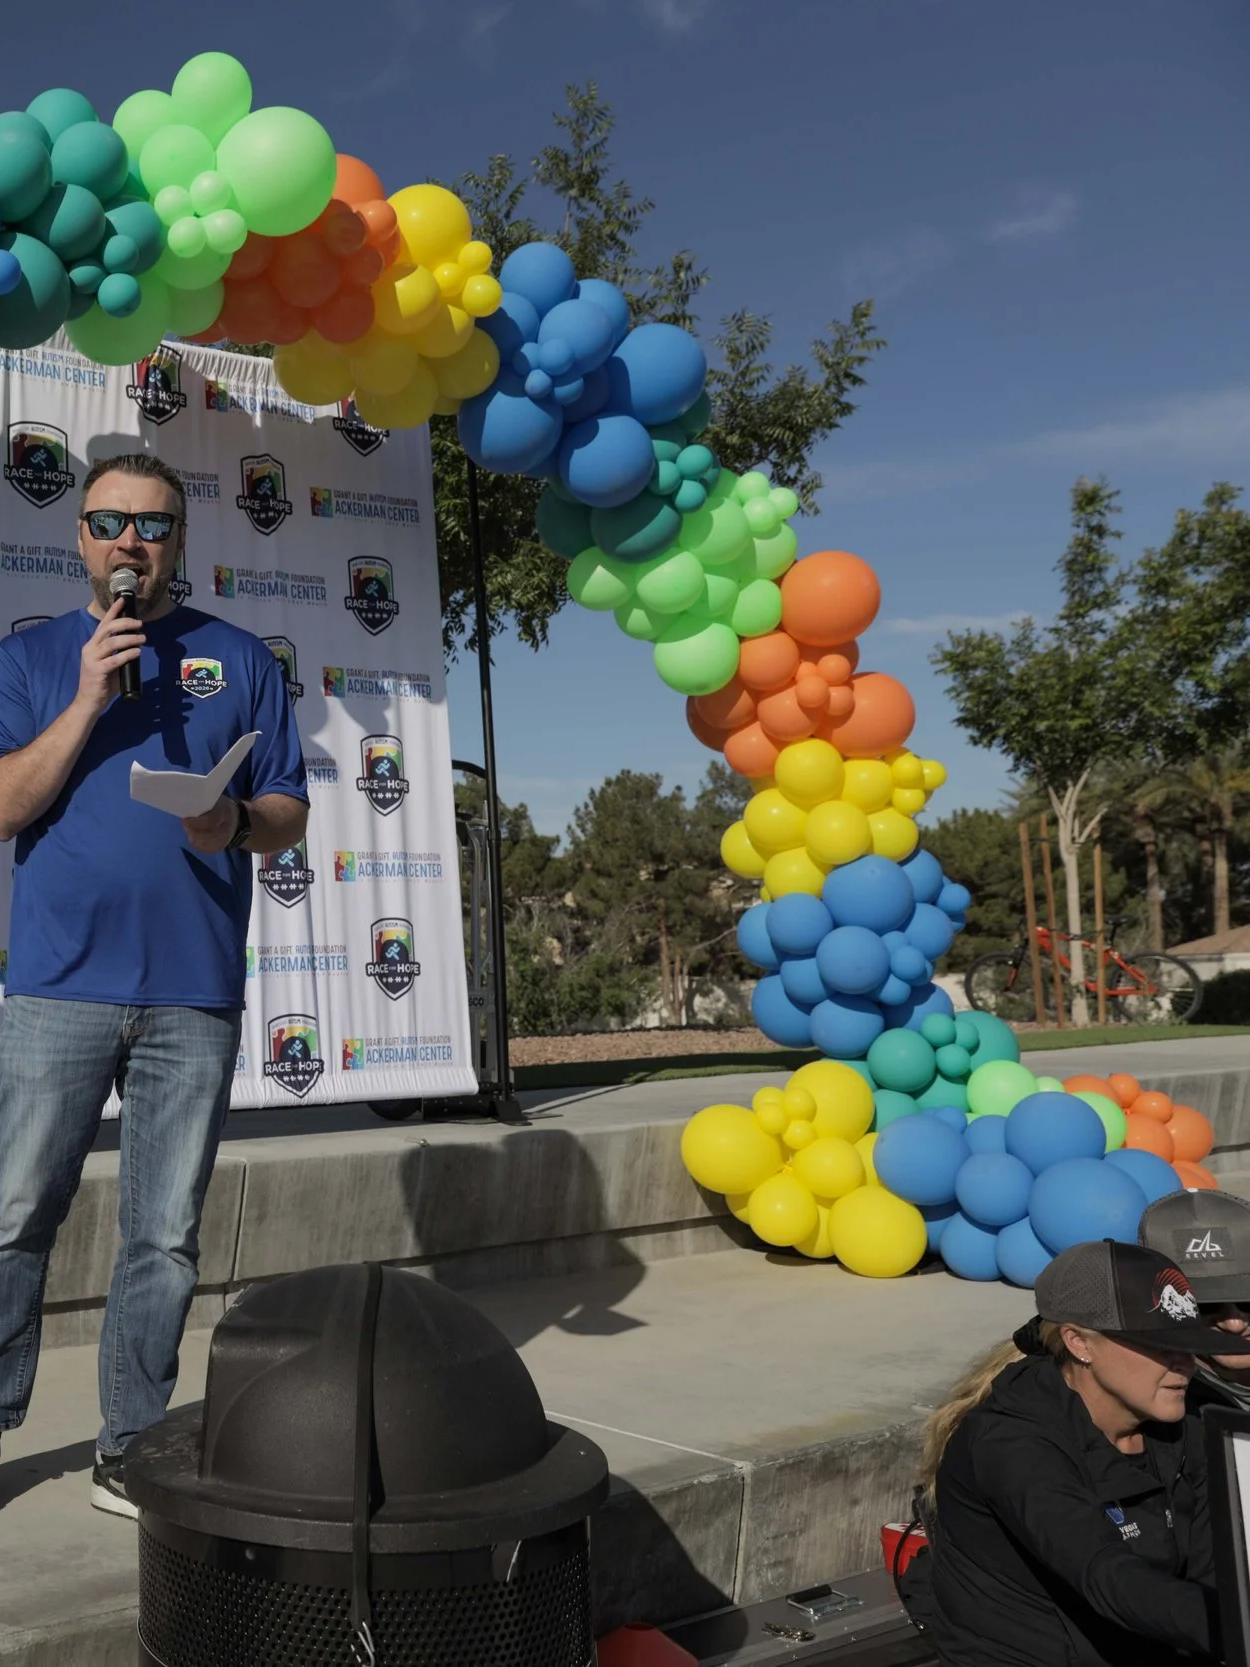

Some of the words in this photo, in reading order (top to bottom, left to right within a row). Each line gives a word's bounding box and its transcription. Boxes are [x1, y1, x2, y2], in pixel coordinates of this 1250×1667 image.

[42, 351, 64, 364] AUTISM
[65, 367, 106, 387] CENTER
[159, 391, 185, 405] HOPE
[281, 402, 315, 420] CENTER
[335, 420, 357, 430] RACE
[5, 467, 33, 478] RACE
[44, 471, 73, 485] HOPE
[238, 498, 260, 510] RACE
[270, 498, 291, 512] HOPE
[333, 490, 351, 499] GRANT
[369, 493, 386, 504] AUTISM
[387, 496, 418, 507] FOUNDATION
[335, 500, 386, 519] ACKERMAN
[388, 506, 419, 523] CENTER
[20, 545, 25, 554] A
[44, 547, 66, 558] AUTISM
[67, 561, 87, 579] CEN
[291, 573, 325, 585] FOUNDATION
[291, 584, 326, 600] CENTER
[346, 599, 368, 608] RACE
[346, 668, 363, 678] GRANT
[347, 678, 397, 696] ACKERMAN
[399, 683, 431, 698] CENTER
[358, 779, 378, 789] RACE
[387, 780, 408, 791] HOPE
[409, 852, 441, 861] FOUNDATION
[259, 870, 282, 880] RACE
[410, 863, 442, 877] CENTER
[274, 947, 278, 955] A
[259, 956, 313, 973] ACKERMAN
[368, 964, 388, 974] RACE
[397, 964, 419, 973] HOPE
[366, 1037, 382, 1047] GRANT
[420, 1035, 451, 1044] FOUNDATION
[366, 1047, 417, 1063] ACKERMAN
[420, 1046, 452, 1061] CENTER
[265, 1062, 291, 1074] RACE
